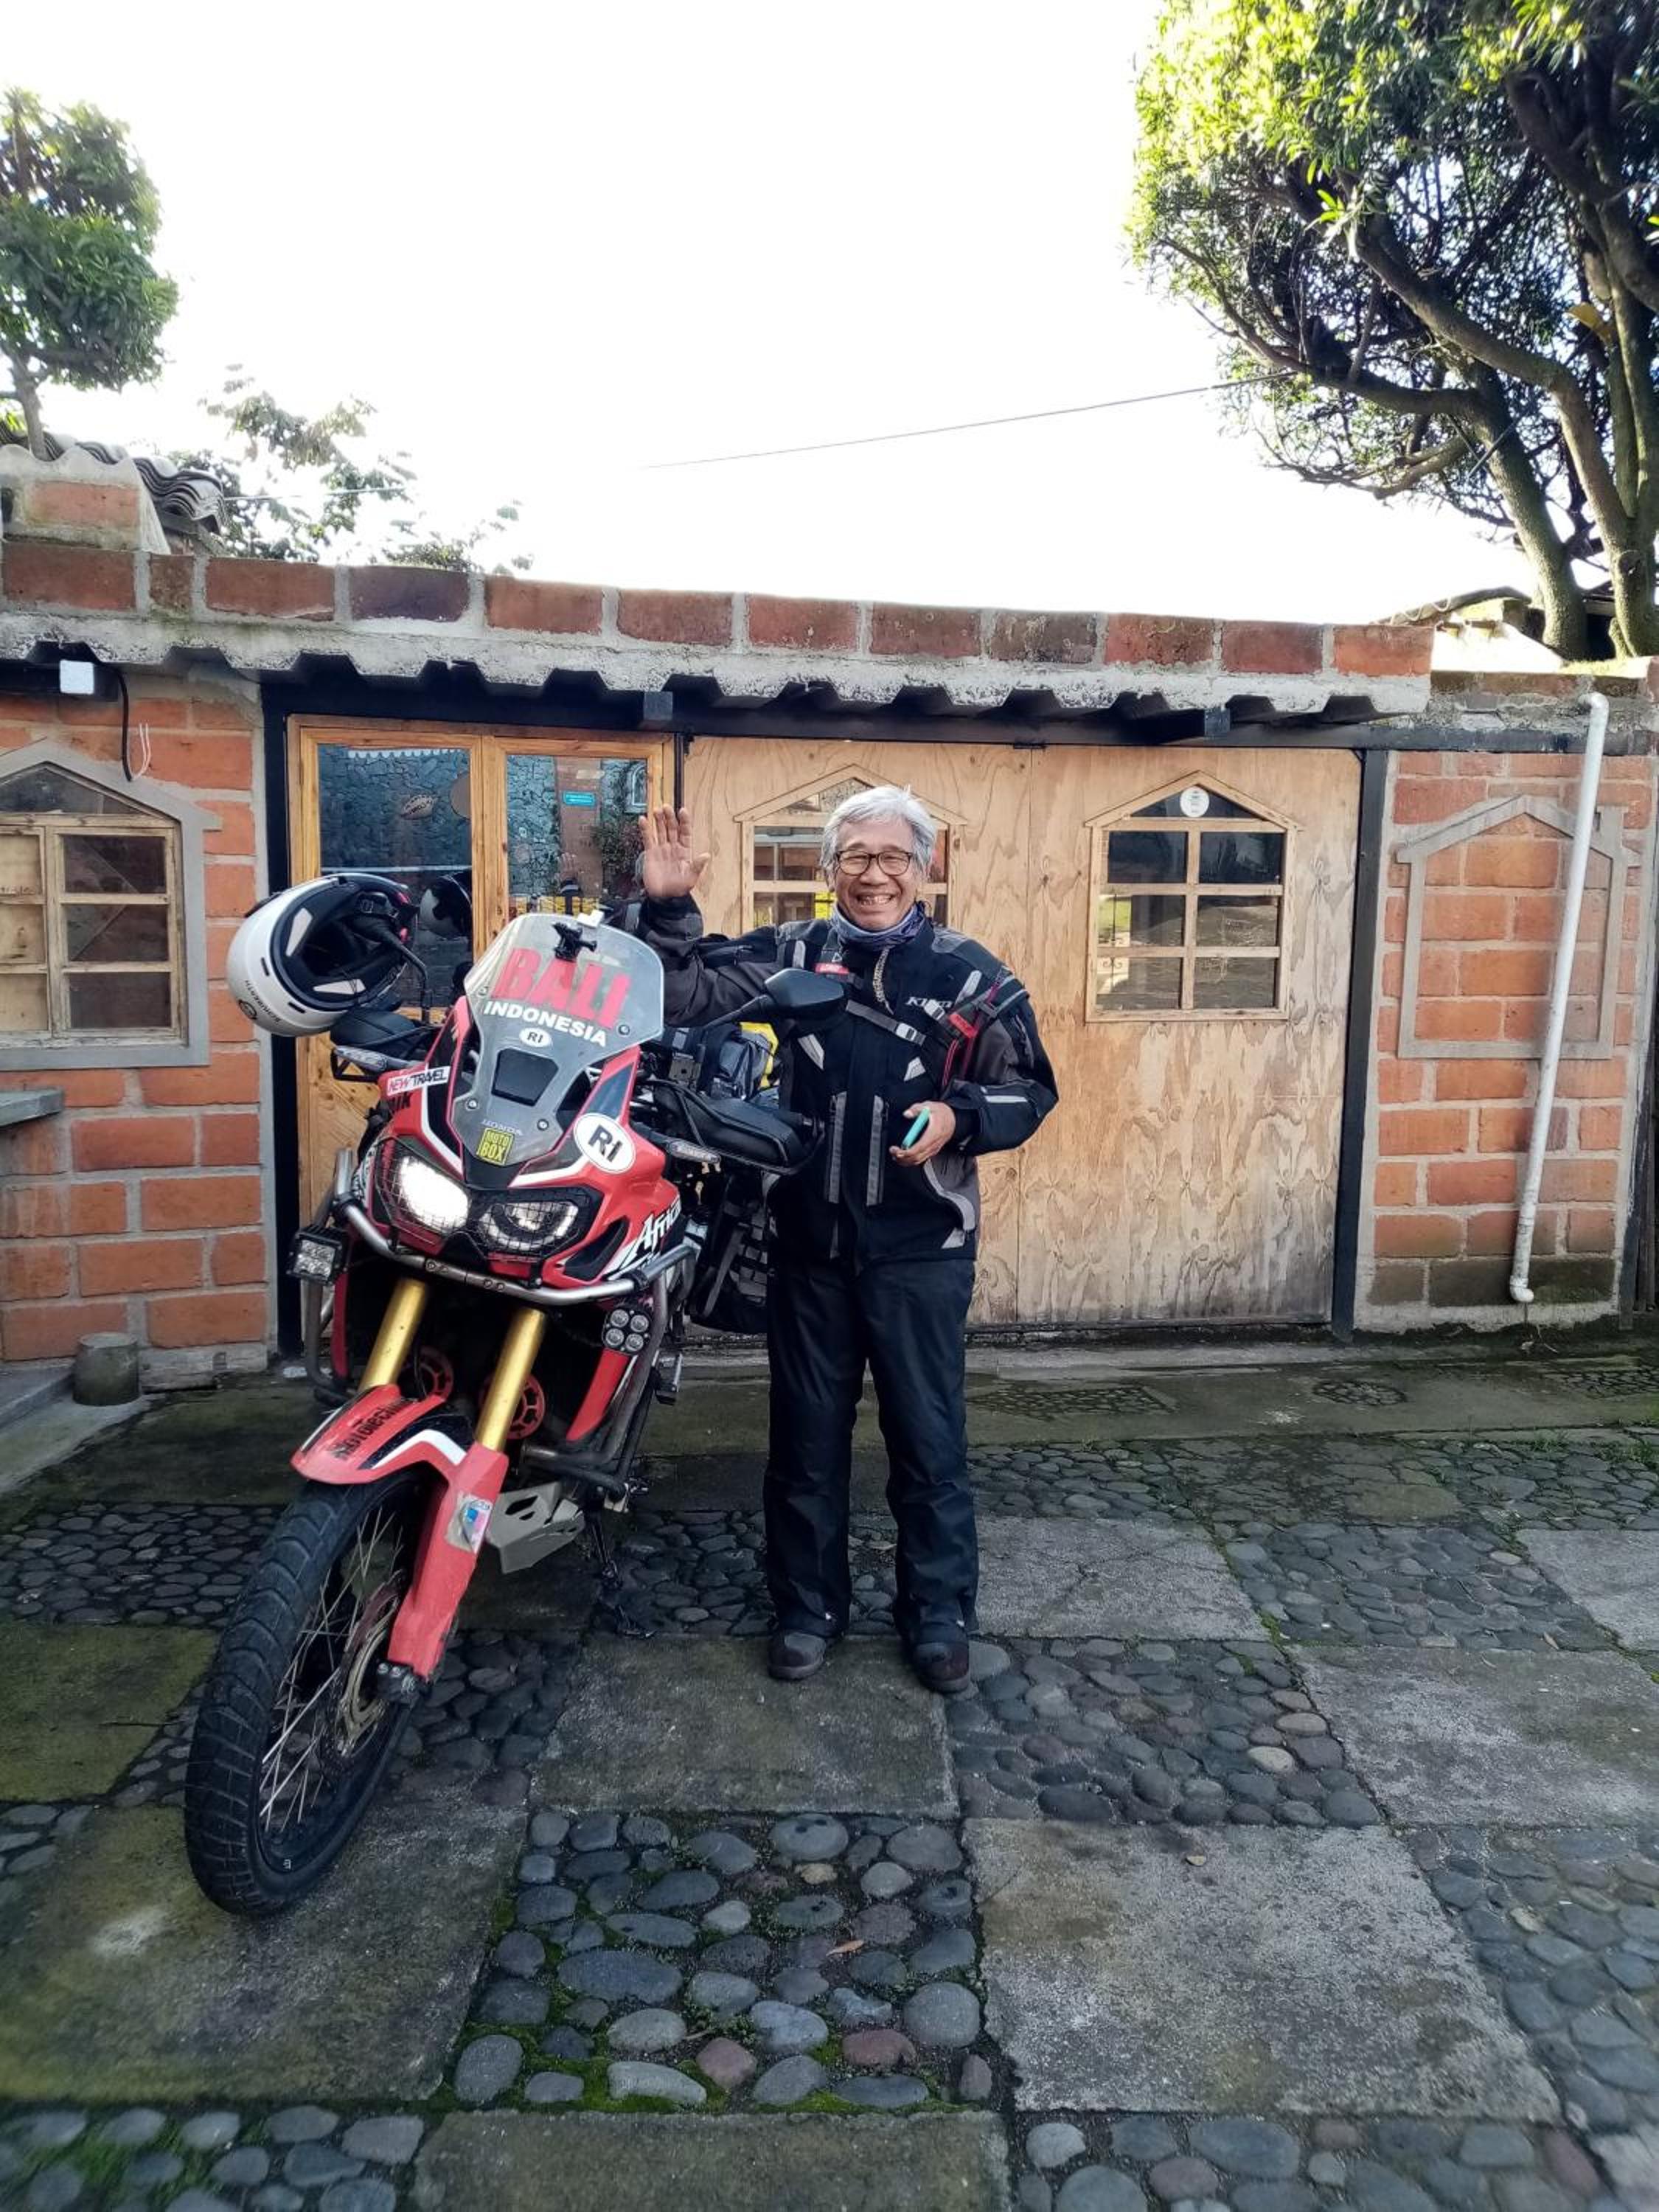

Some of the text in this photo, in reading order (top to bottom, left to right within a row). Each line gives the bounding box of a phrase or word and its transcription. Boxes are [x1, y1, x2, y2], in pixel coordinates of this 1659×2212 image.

[490, 947, 632, 1031] BALI
[484, 1001, 607, 1048] INDONESIA
[526, 1034, 543, 1043] RI
[410, 1068, 447, 1087] TRAVEL
[485, 1130, 509, 1147] MOTO
[589, 1123, 623, 1163] RI
[480, 1142, 506, 1163] BOX
